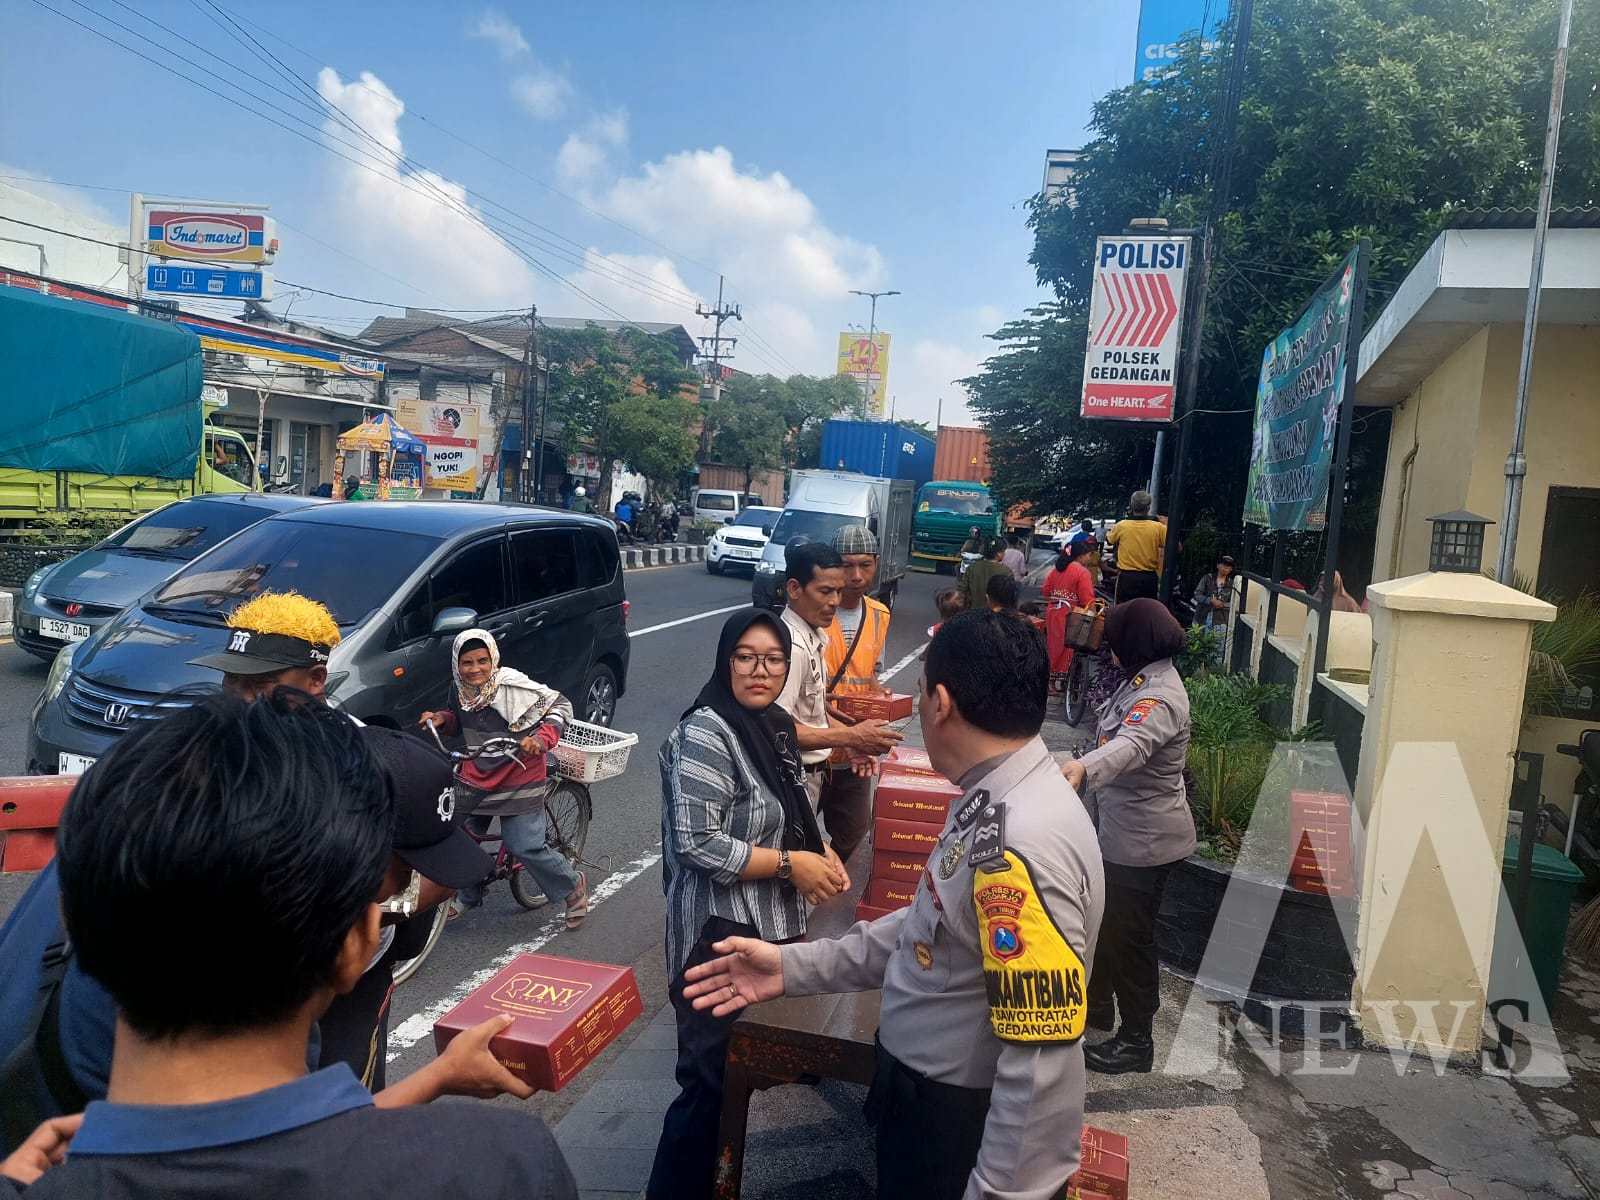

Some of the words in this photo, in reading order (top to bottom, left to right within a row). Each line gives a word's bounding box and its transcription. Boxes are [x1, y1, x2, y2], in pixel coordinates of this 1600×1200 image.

[169, 225, 242, 244] Indomaret
[1100, 243, 1185, 269] POLISI
[1103, 351, 1160, 365] POLSEK
[1091, 366, 1171, 381] GEDANGAN
[1088, 395, 1109, 407] One
[1110, 396, 1146, 409] HEART.
[433, 451, 463, 461] NGOPI
[437, 463, 458, 473] YUK!
[41, 619, 47, 630] L
[50, 621, 70, 634] 1527
[73, 625, 89, 638] DAG
[61, 755, 69, 772] W
[997, 1022, 1073, 1036] GEDANGAN
